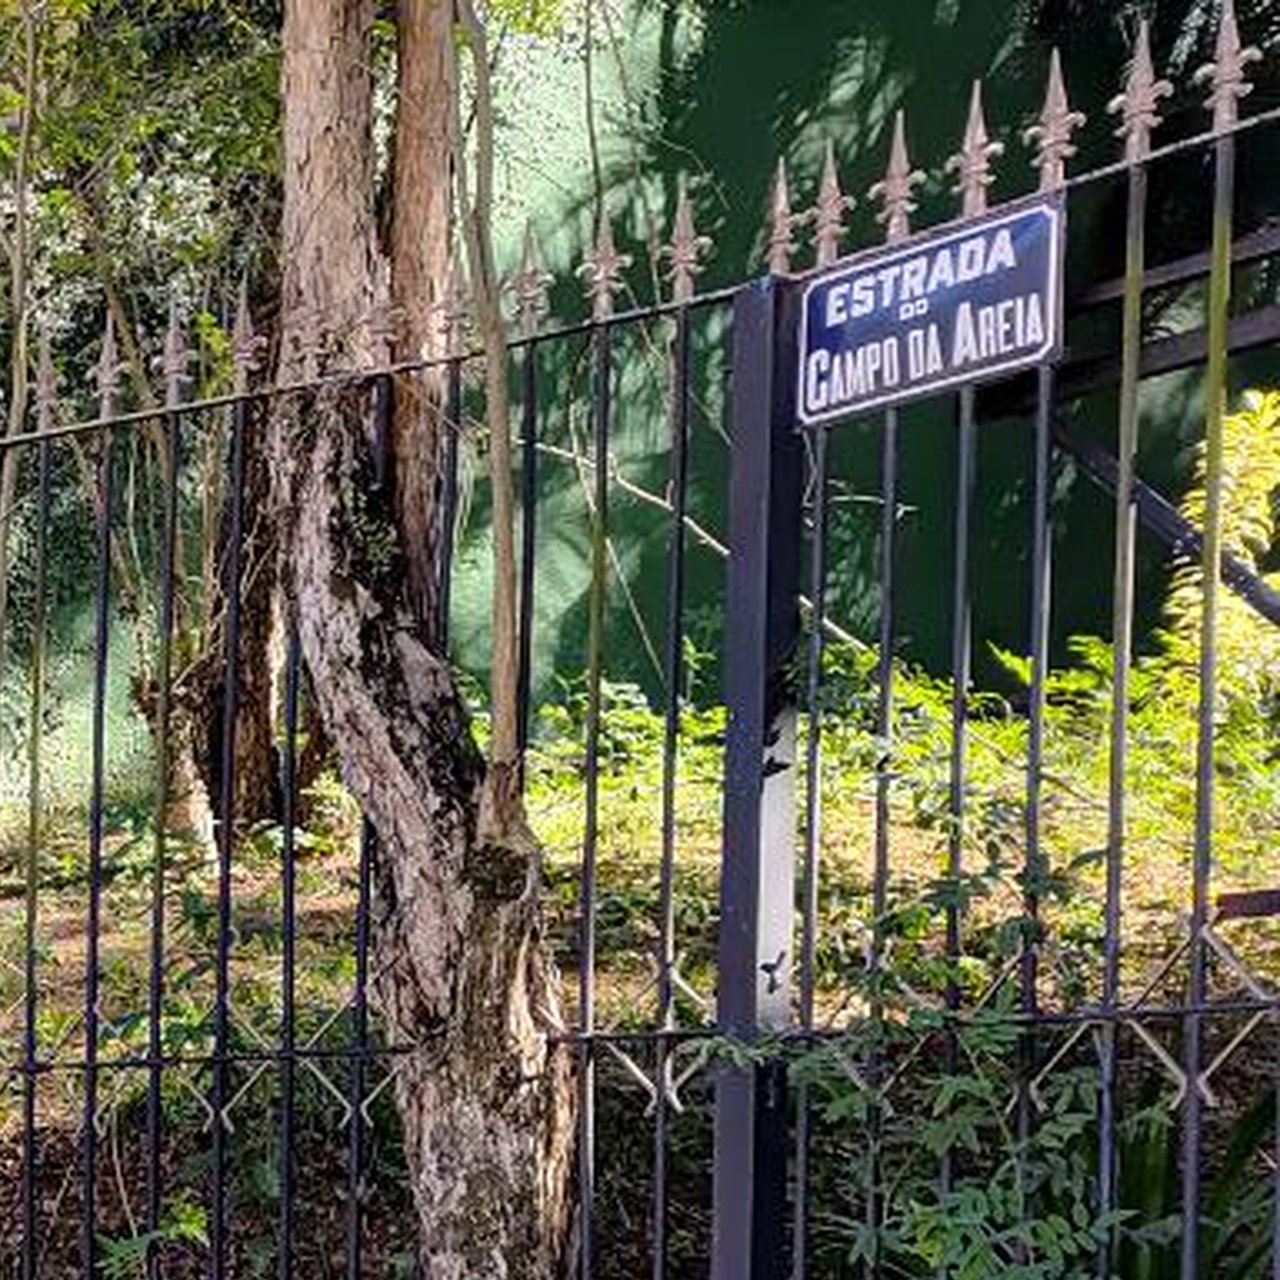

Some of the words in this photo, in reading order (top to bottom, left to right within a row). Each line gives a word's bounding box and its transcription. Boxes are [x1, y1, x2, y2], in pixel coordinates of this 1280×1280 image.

[826, 229, 1016, 327] ESTRADA
[899, 298, 929, 320] DO
[806, 337, 900, 411] CAMPO
[909, 323, 944, 380] DA
[952, 292, 1044, 367] AREIA
